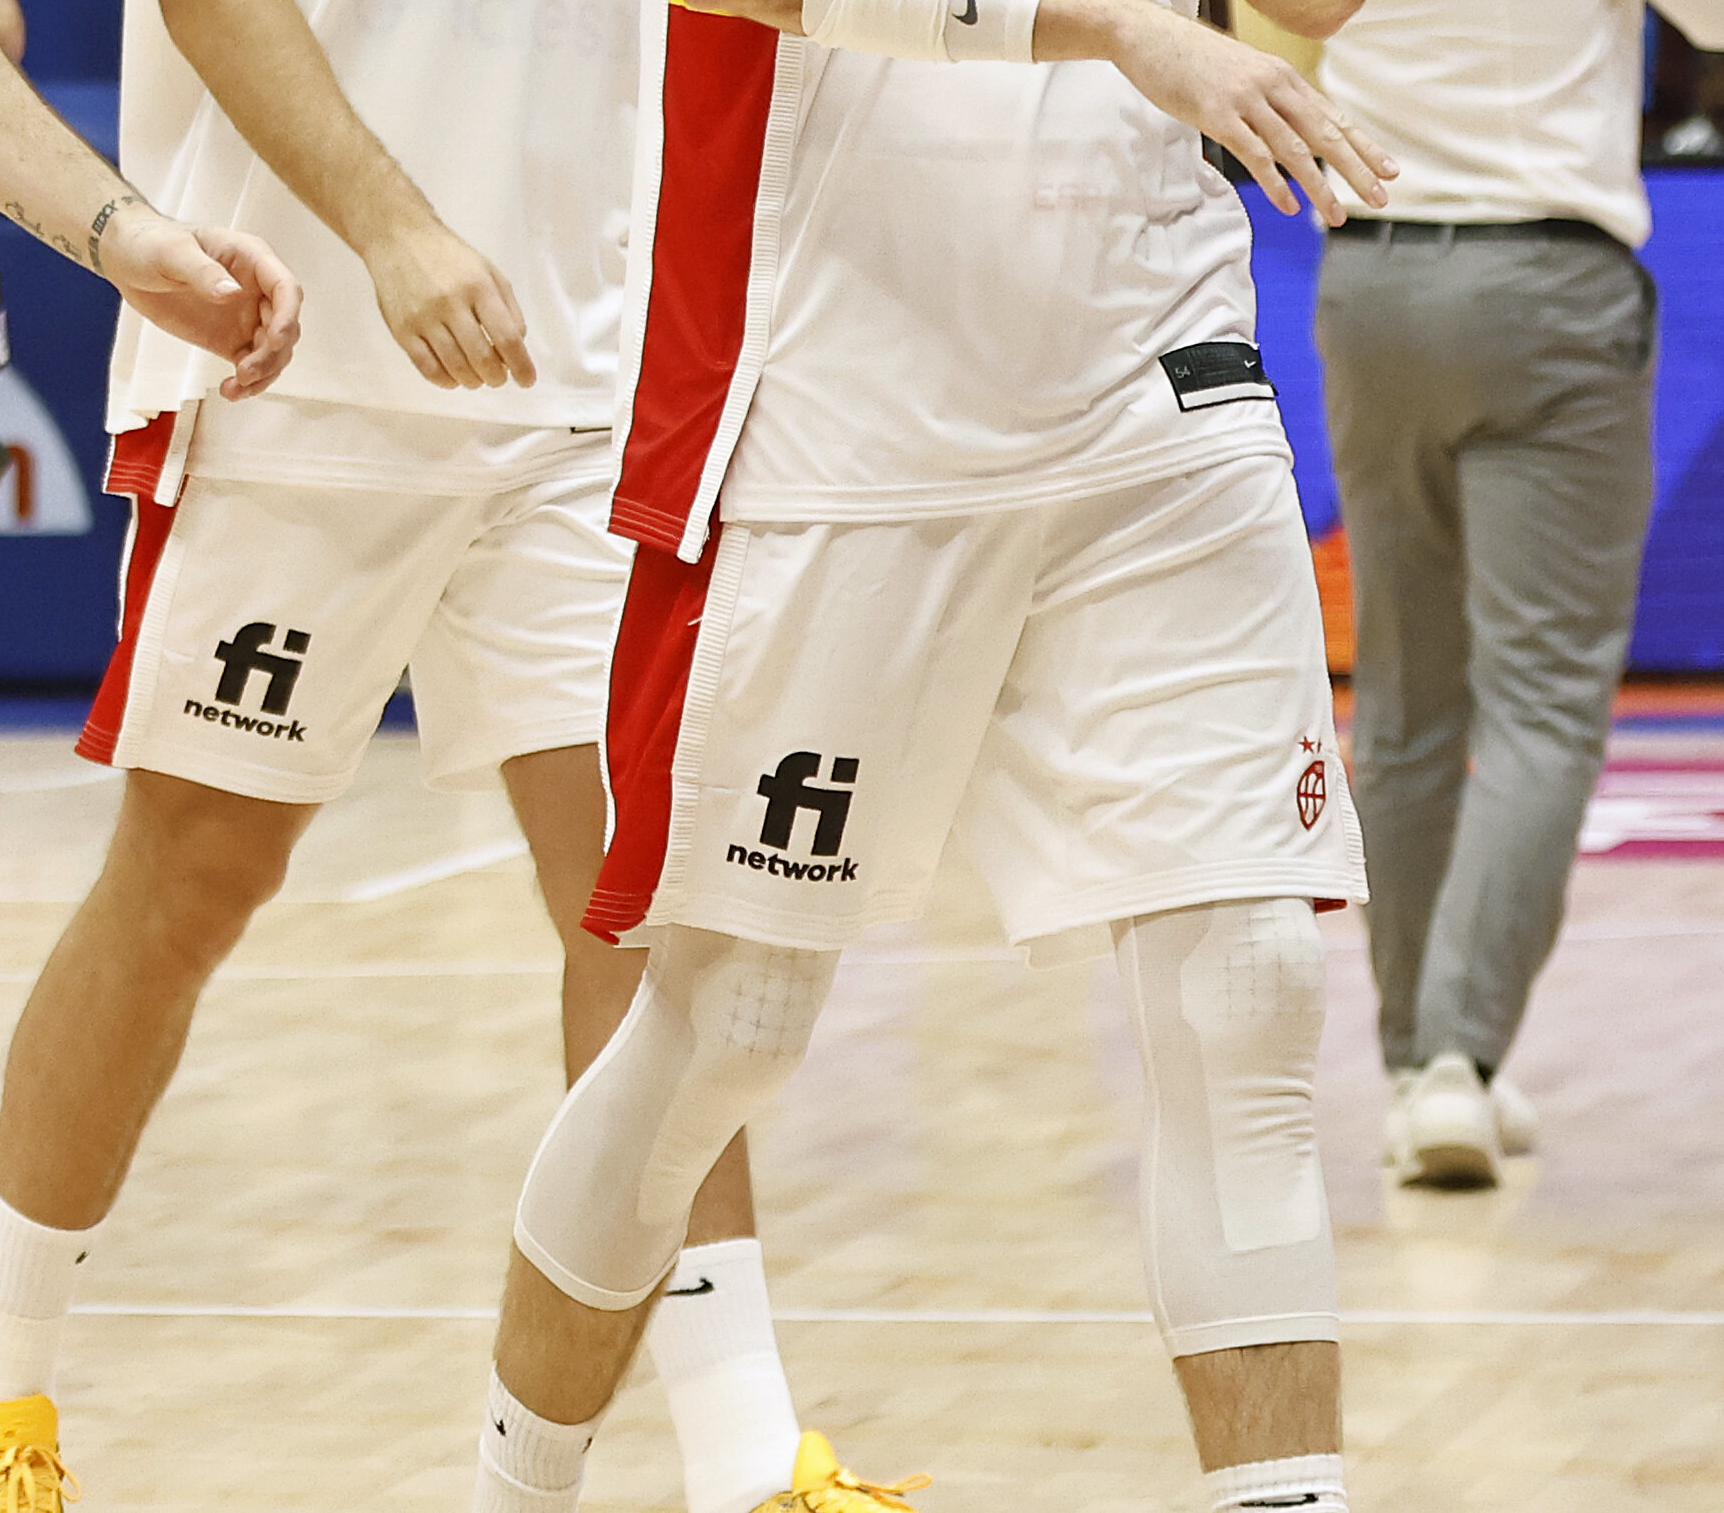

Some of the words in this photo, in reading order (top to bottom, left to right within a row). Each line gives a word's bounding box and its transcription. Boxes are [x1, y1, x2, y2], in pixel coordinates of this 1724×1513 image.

[214, 622, 312, 716] fi
[183, 699, 308, 743] network
[757, 751, 860, 856] fi
[726, 844, 860, 882] network
